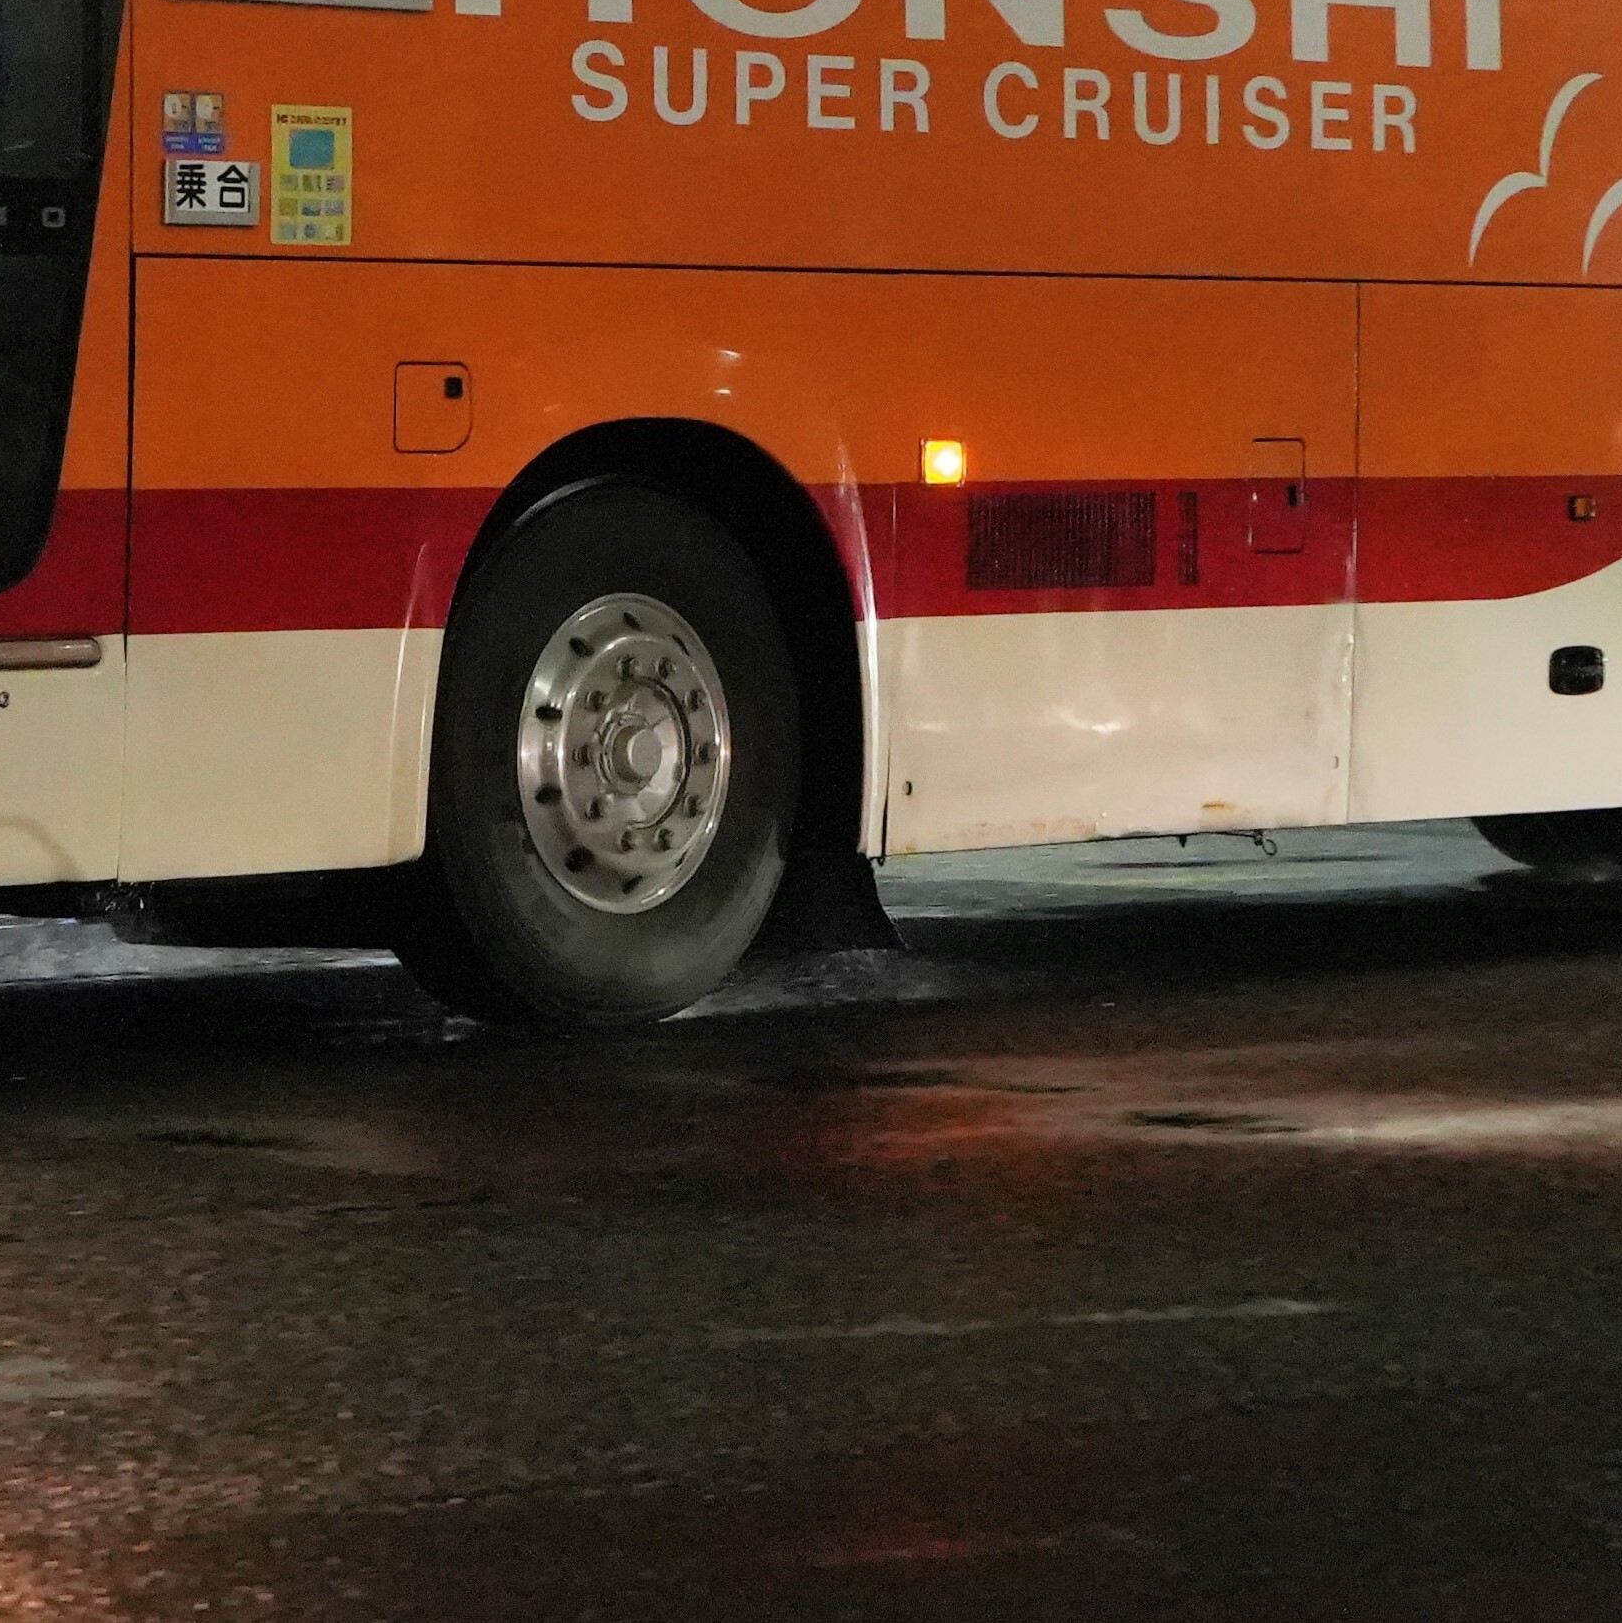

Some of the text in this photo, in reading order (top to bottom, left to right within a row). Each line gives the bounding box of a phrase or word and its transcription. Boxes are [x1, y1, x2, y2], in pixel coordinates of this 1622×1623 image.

[570, 39, 1418, 155] SUPER CRUISER
[176, 163, 249, 209] 乗合
